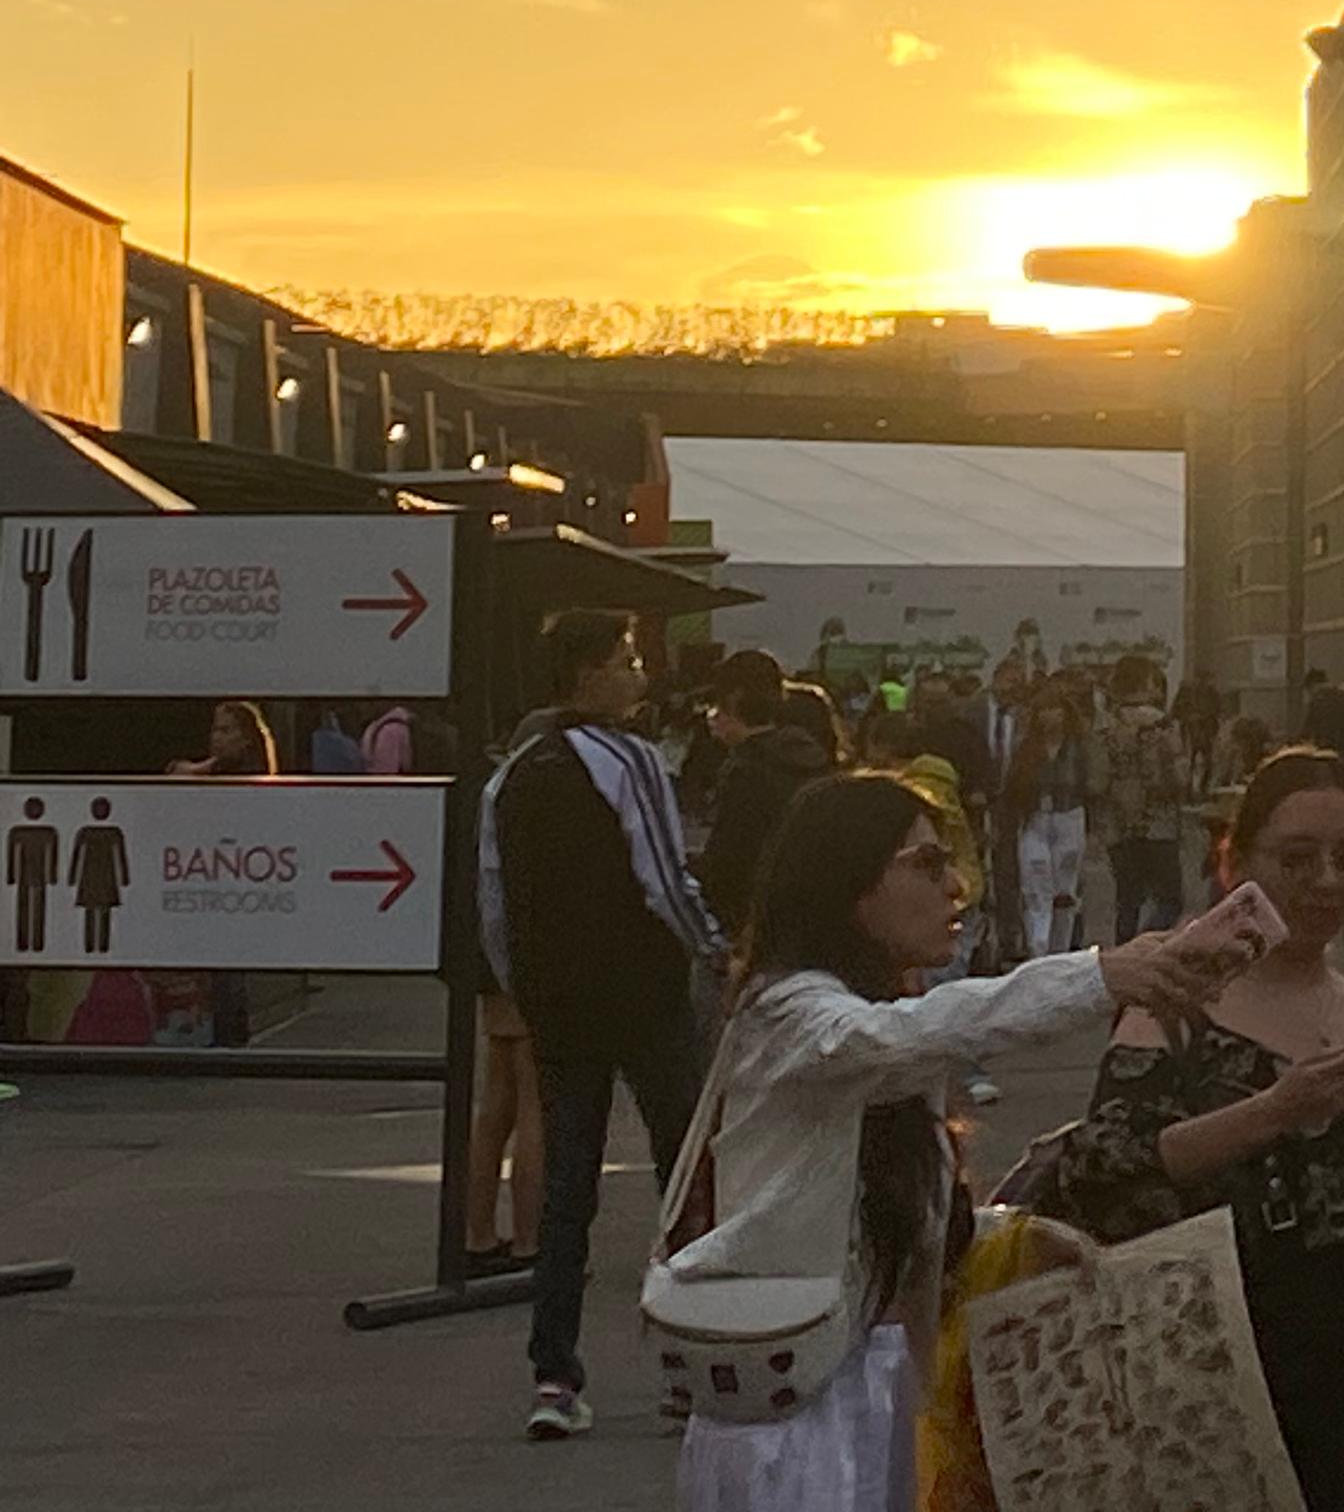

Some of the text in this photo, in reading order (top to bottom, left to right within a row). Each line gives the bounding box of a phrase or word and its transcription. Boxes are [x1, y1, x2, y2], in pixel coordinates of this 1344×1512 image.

[148, 567, 280, 592] PLAZOLETA
[147, 594, 280, 615] DE COMIDAS
[145, 620, 280, 642] FOOD COURT
[163, 838, 297, 883] BAÑOS
[161, 890, 297, 914] RESTROOMS
